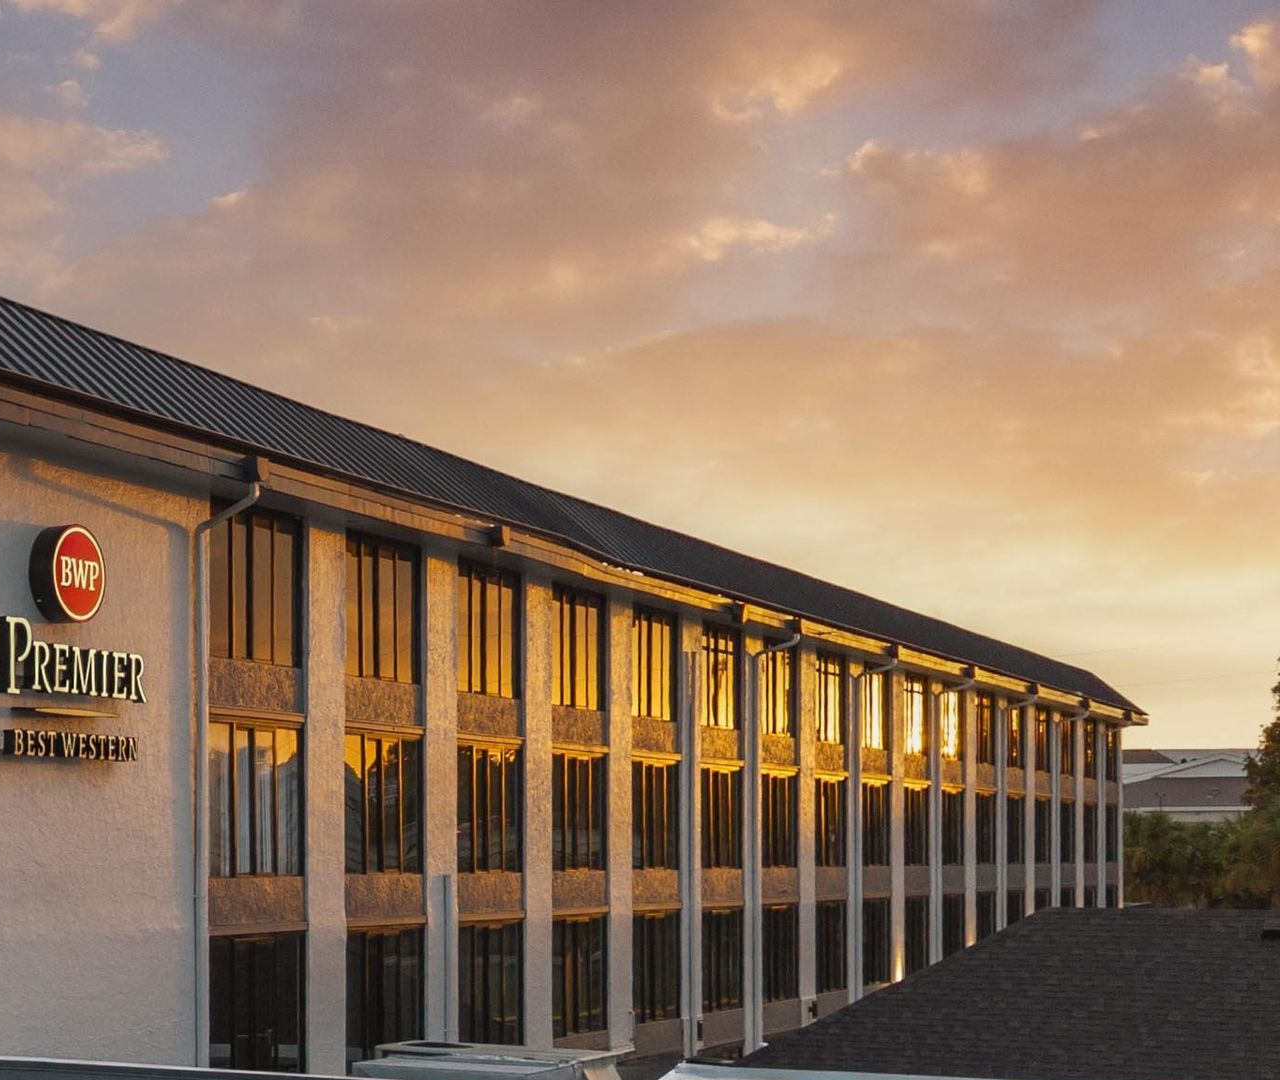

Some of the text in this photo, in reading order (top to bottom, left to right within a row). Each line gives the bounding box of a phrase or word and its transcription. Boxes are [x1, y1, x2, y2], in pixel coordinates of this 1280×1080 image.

[61, 556, 100, 591] BWP
[6, 616, 147, 702] PREMIER
[15, 729, 139, 761] BEST WESTERN
